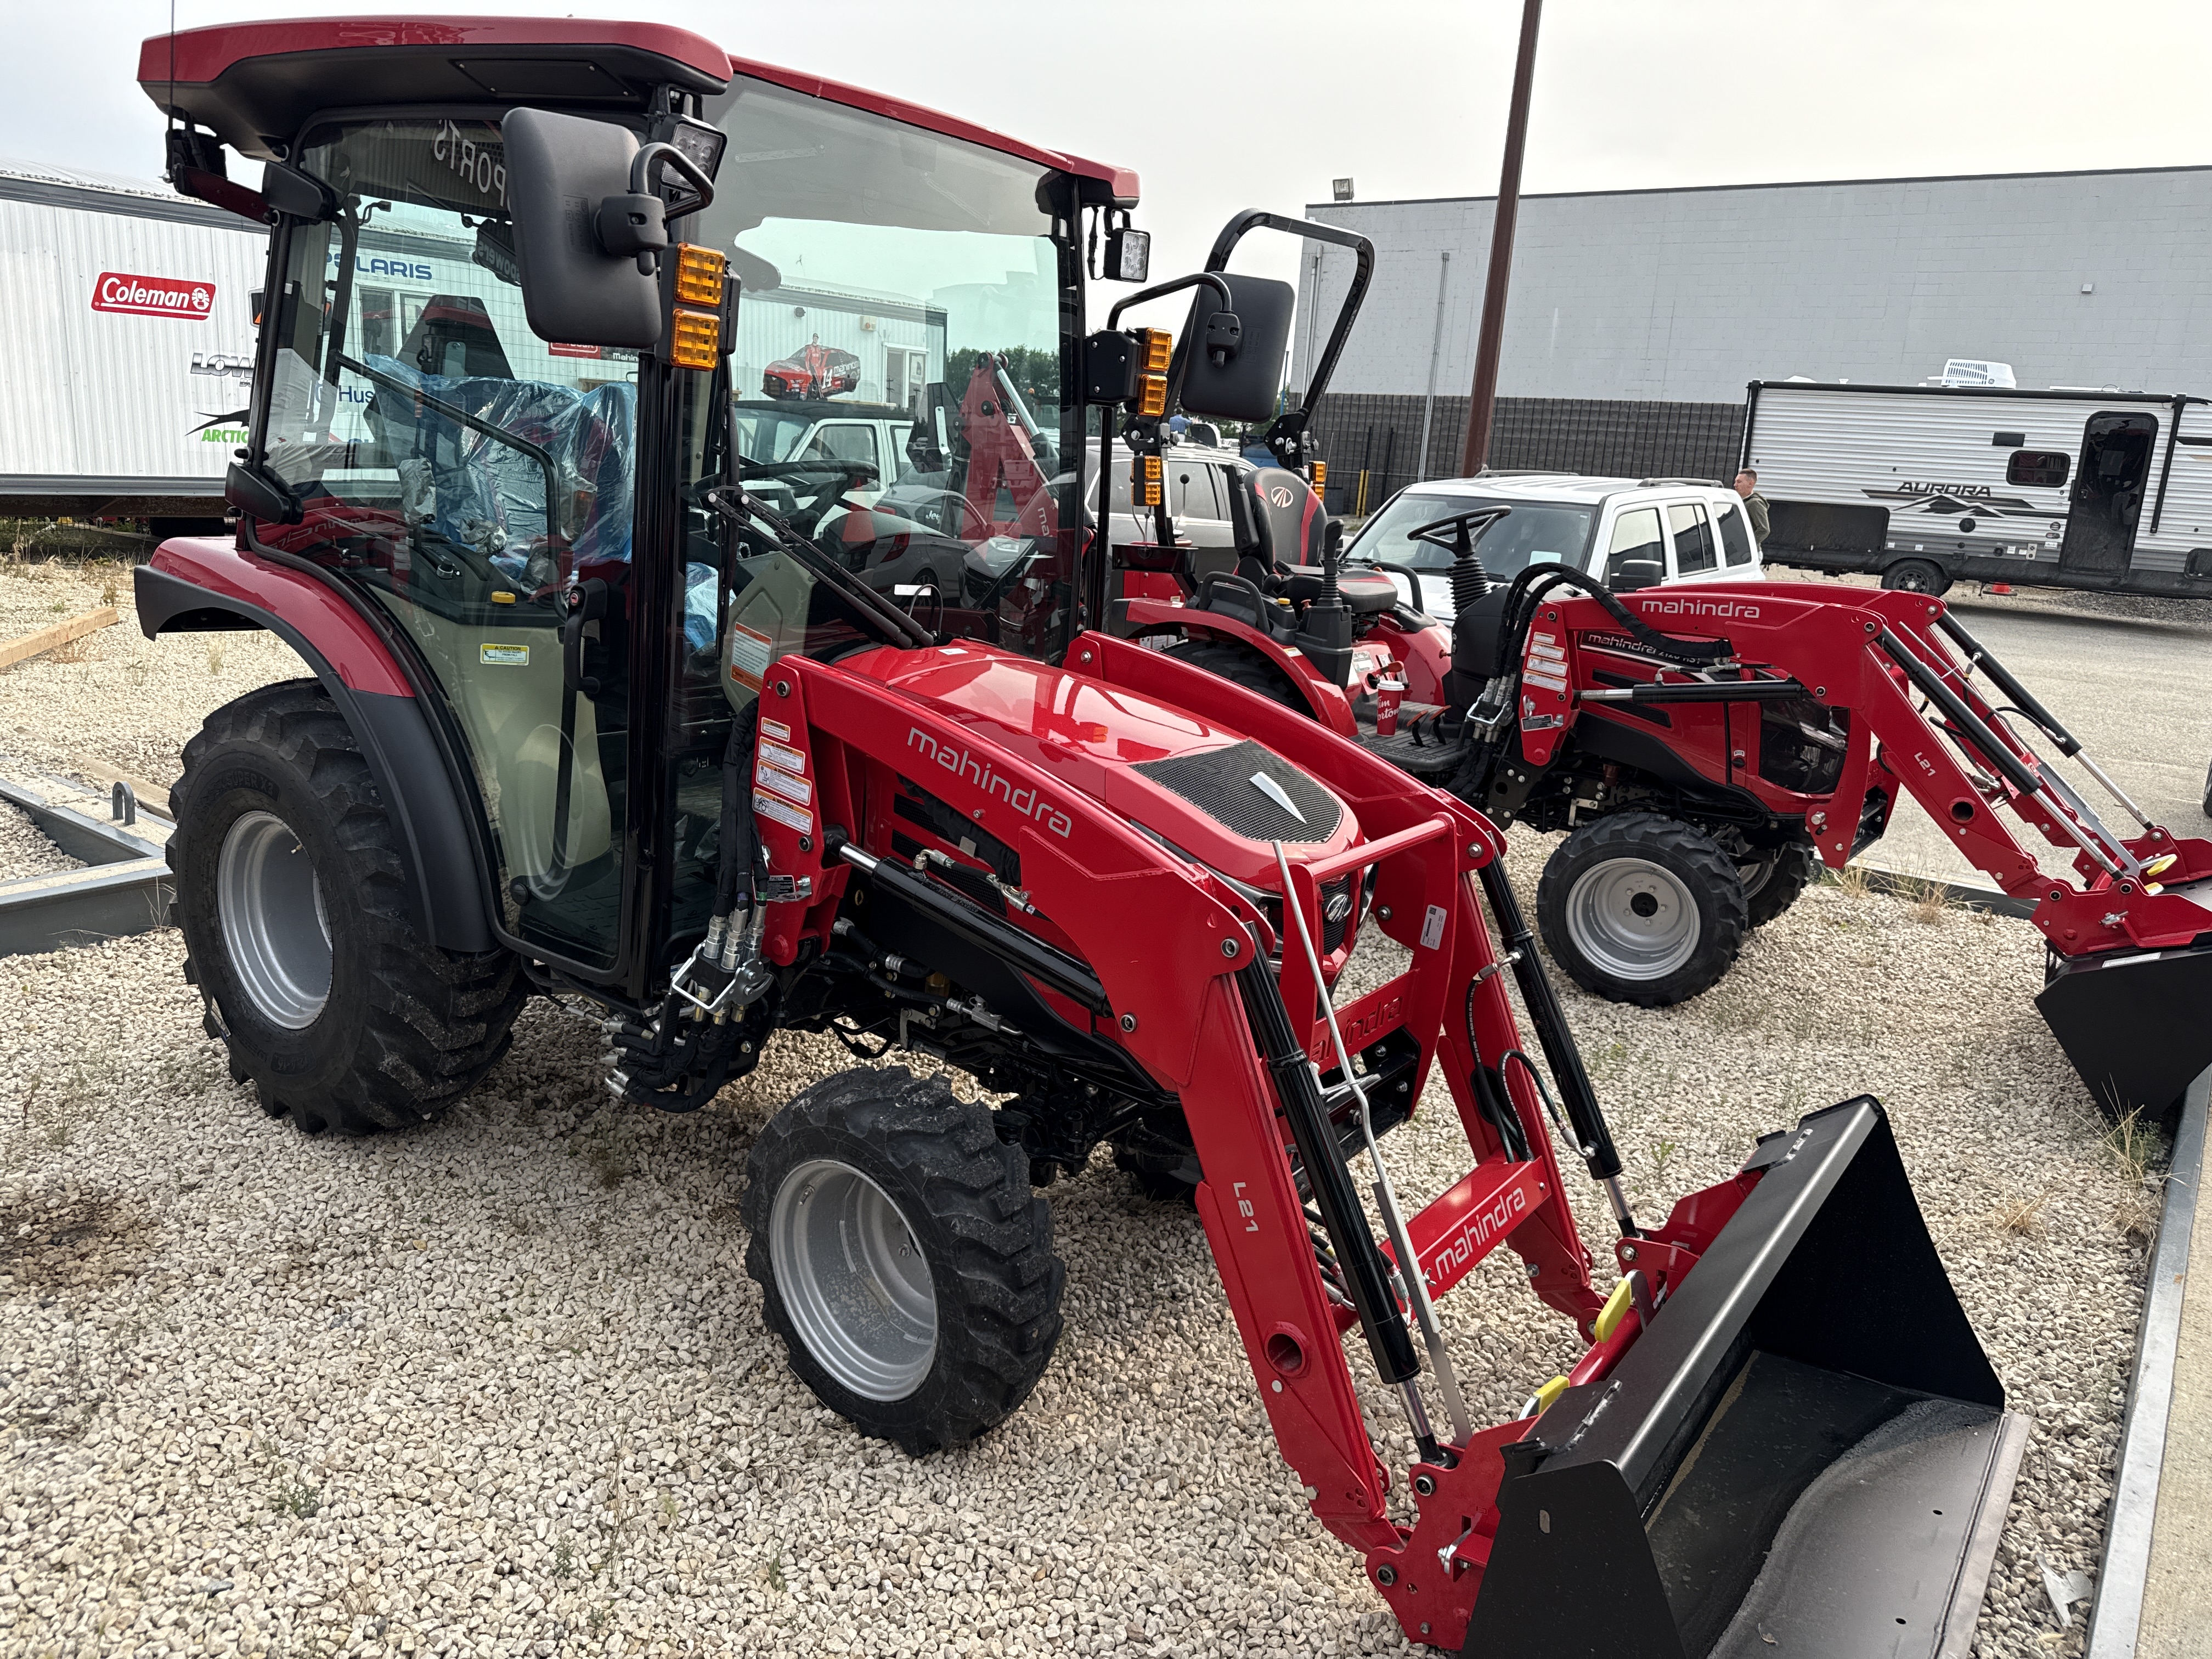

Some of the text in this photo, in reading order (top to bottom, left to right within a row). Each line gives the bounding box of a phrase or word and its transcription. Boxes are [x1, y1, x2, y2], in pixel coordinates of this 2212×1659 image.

[102, 277, 189, 308] Coleman
[822, 369, 833, 390] 14
[1897, 482, 1991, 496] AURORA
[1642, 599, 1760, 618] mahindra
[1588, 634, 1656, 654] mahindra
[1914, 752, 1936, 776] L21
[907, 727, 1072, 838] mahindra
[1233, 1182, 1259, 1232] L21
[1435, 1187, 1526, 1280] mahindra
